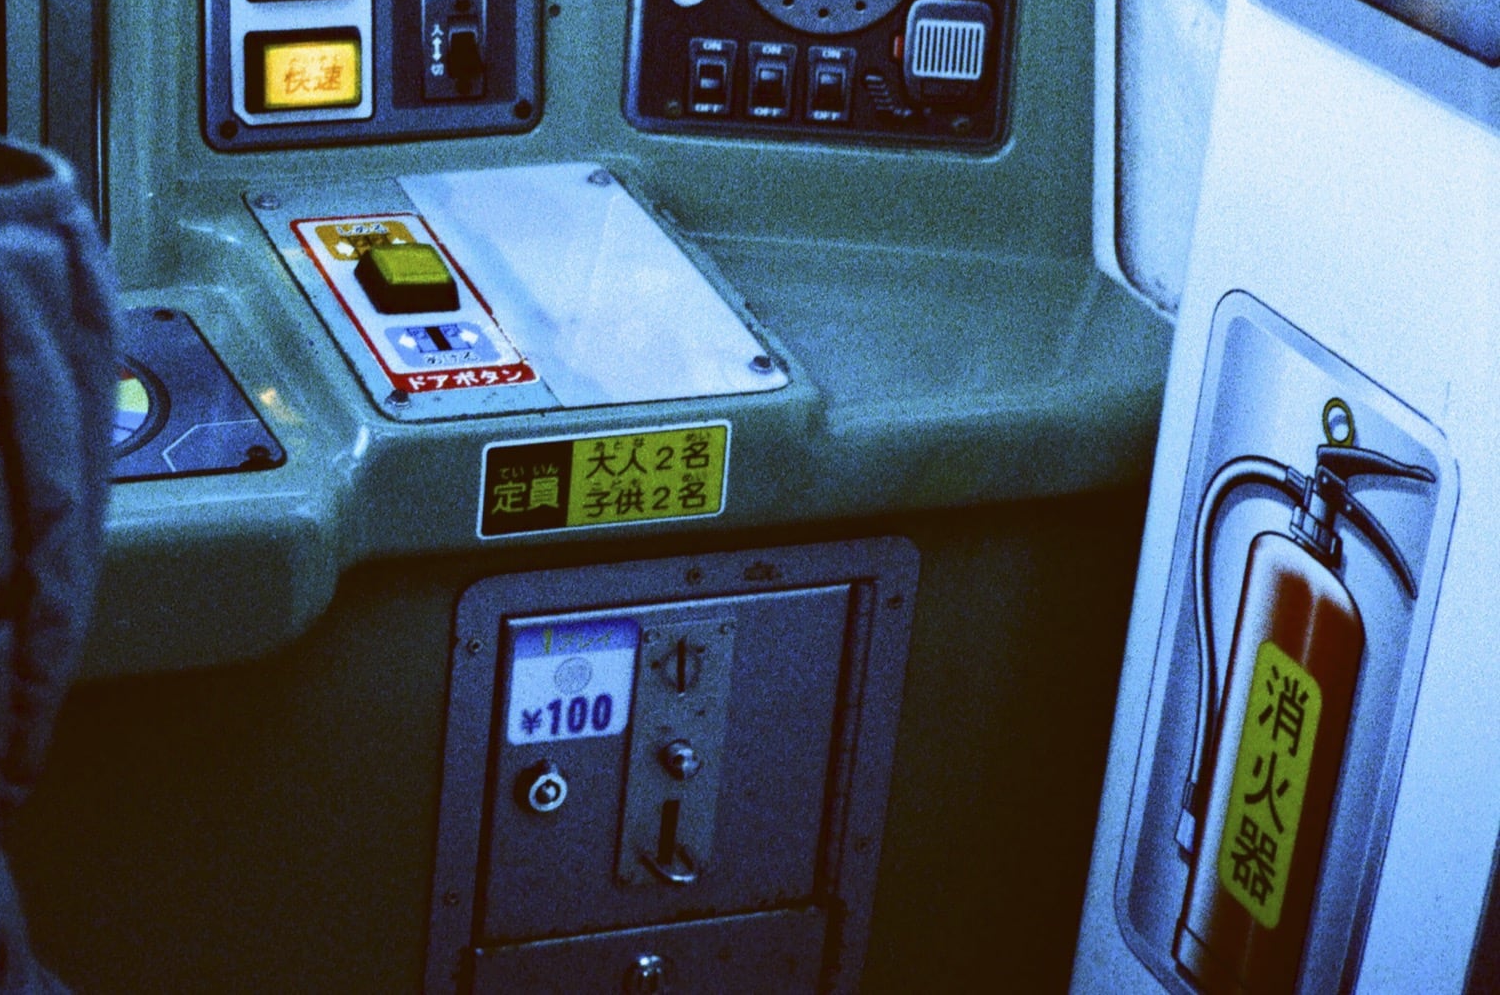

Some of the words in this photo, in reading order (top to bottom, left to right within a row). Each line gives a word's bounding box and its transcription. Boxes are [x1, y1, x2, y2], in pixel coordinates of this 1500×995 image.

[703, 40, 722, 51] ON
[762, 45, 781, 56] ON
[822, 48, 841, 59] ON
[283, 65, 343, 94] 快速
[694, 103, 723, 114] OFF
[754, 107, 782, 118] OFF
[407, 369, 523, 390] ドアボタン
[533, 464, 558, 476] いん
[586, 441, 711, 479] 大人2名
[492, 477, 559, 515] 定員
[583, 481, 707, 518] 子供2名
[522, 693, 612, 736] ¥100
[1231, 665, 1309, 906] 消火器
